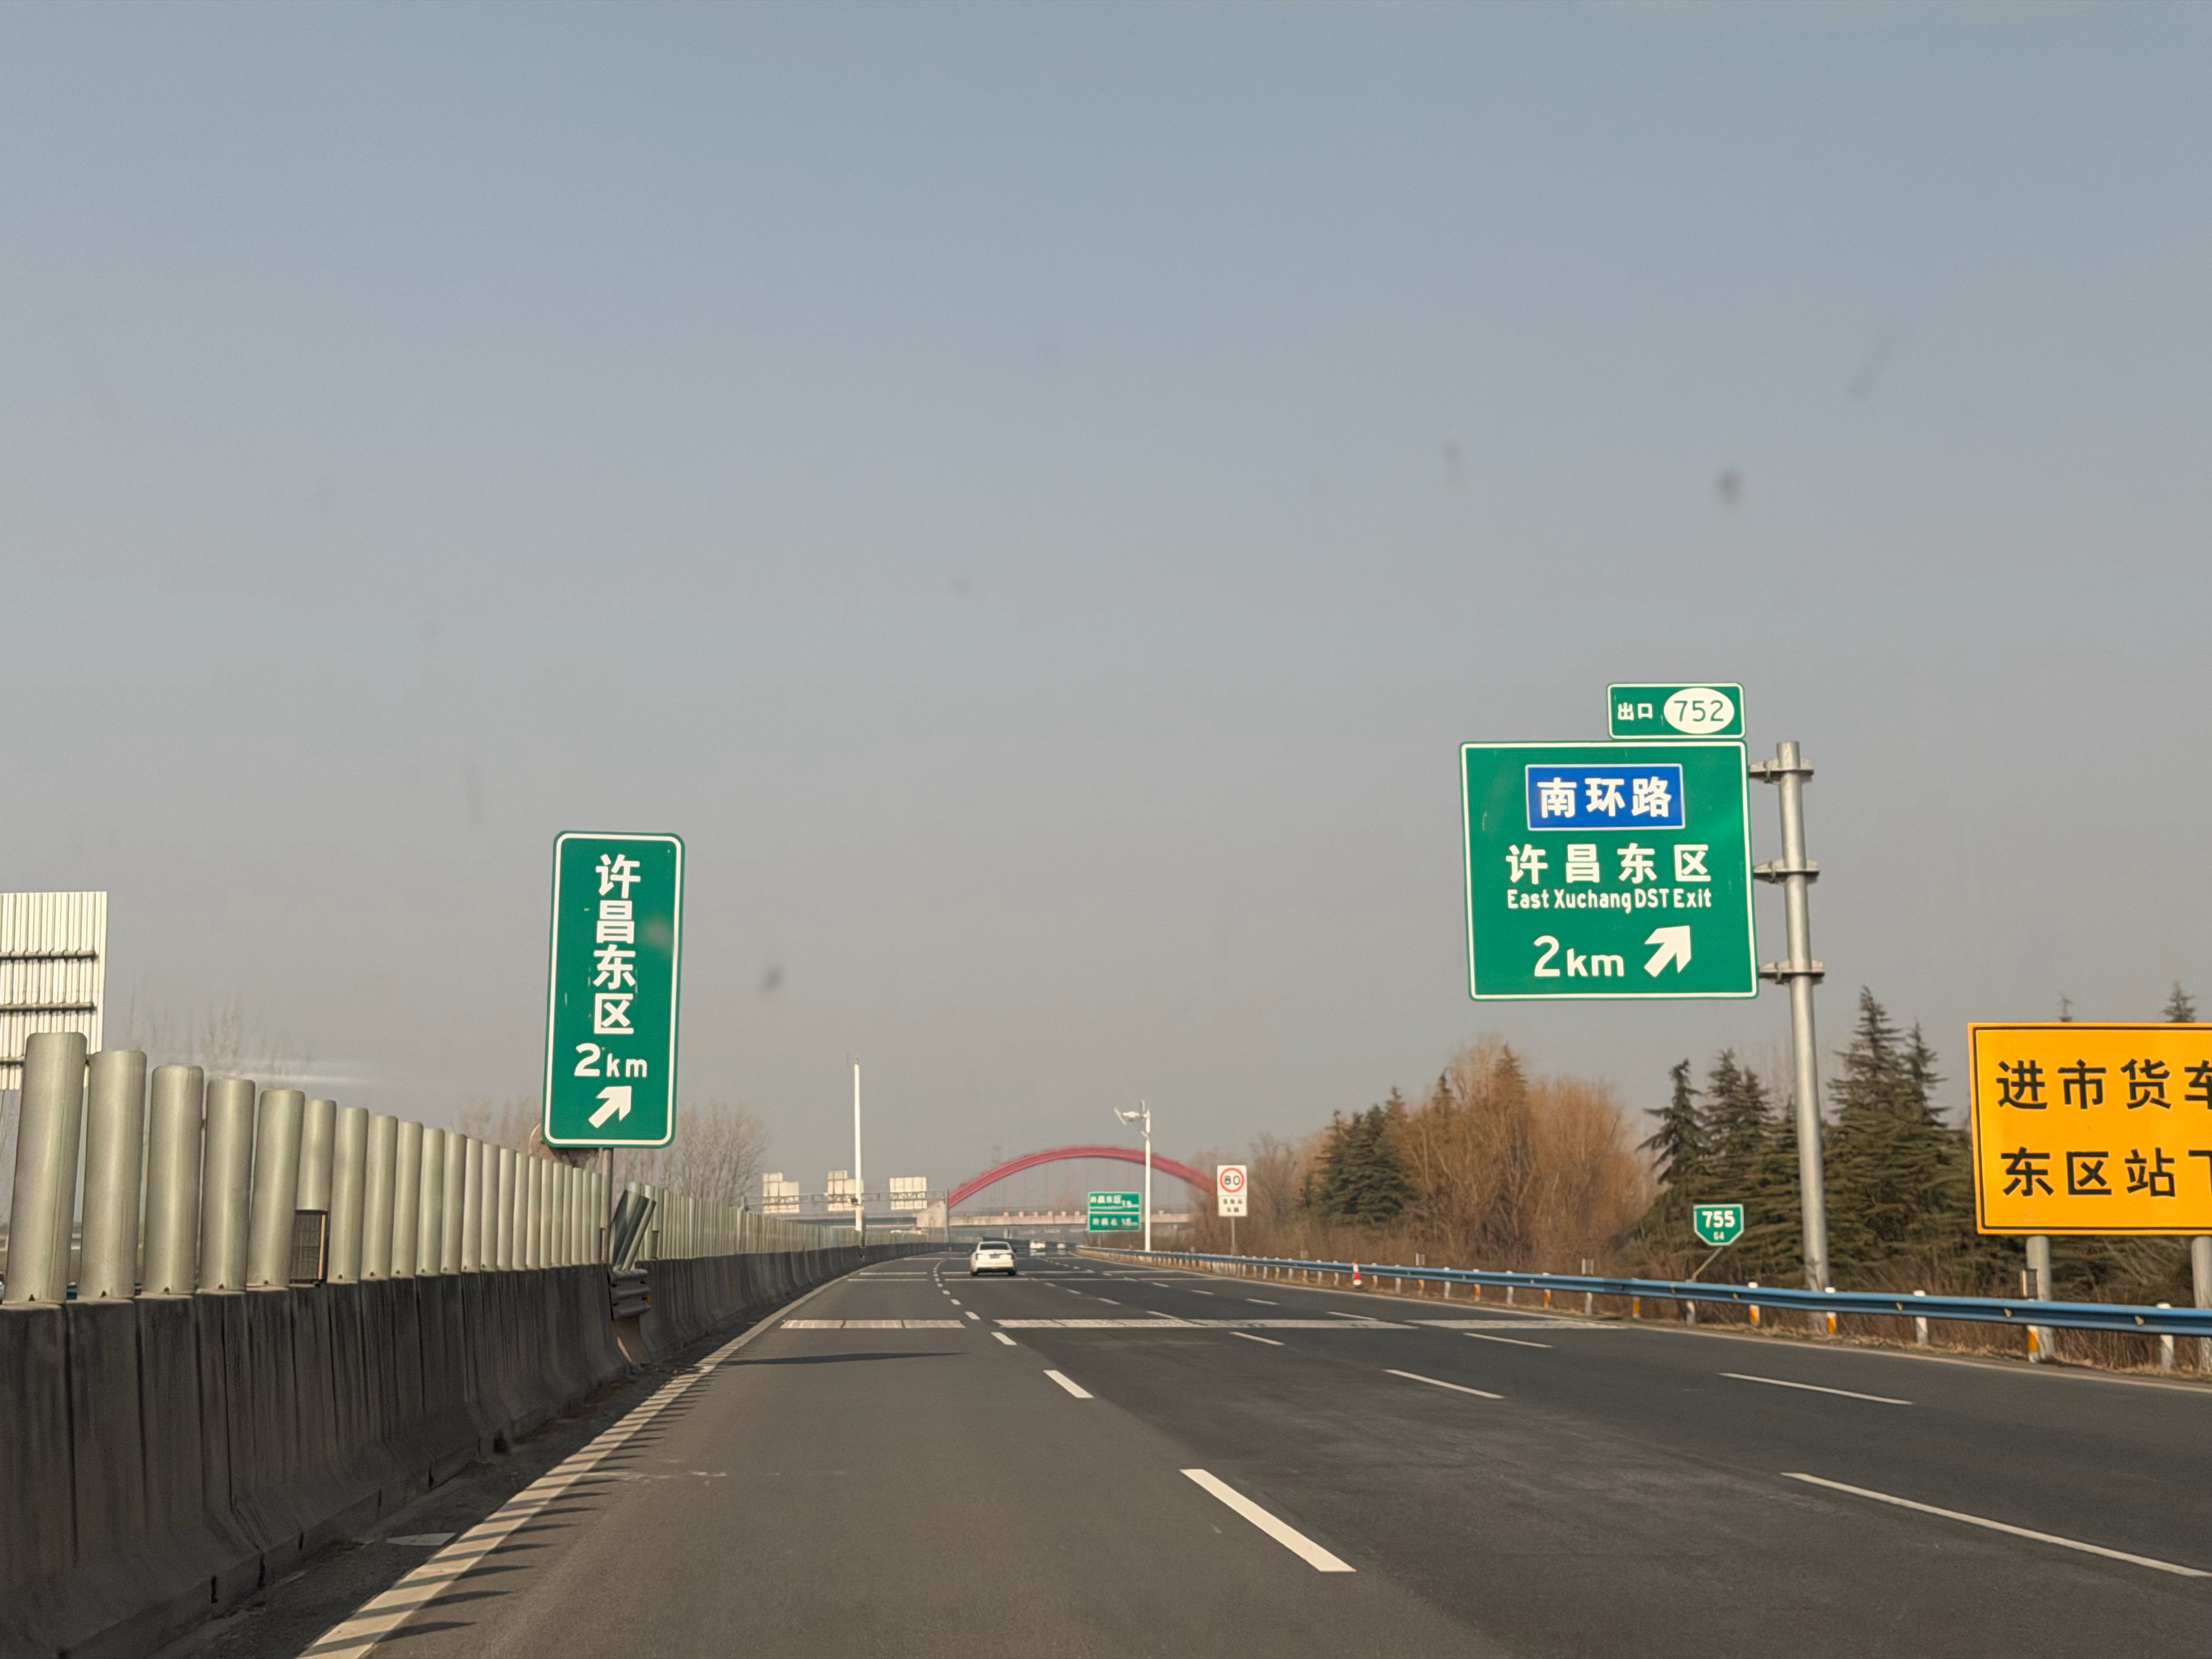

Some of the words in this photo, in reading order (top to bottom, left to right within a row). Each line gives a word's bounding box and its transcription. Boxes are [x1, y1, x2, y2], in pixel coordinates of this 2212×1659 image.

[1617, 702, 1653, 721] 出口
[1673, 700, 1724, 723] 752
[1537, 776, 1672, 819] 南环路
[1505, 843, 1711, 885] 许昌东区
[1507, 889, 1549, 909] East
[1554, 889, 1632, 914] Xuchang
[1634, 888, 1669, 909] DST
[1673, 888, 1712, 909] Exit
[592, 854, 641, 1035] 许昌东区
[1533, 935, 1624, 977] 2km
[1701, 1210, 1736, 1228] 755
